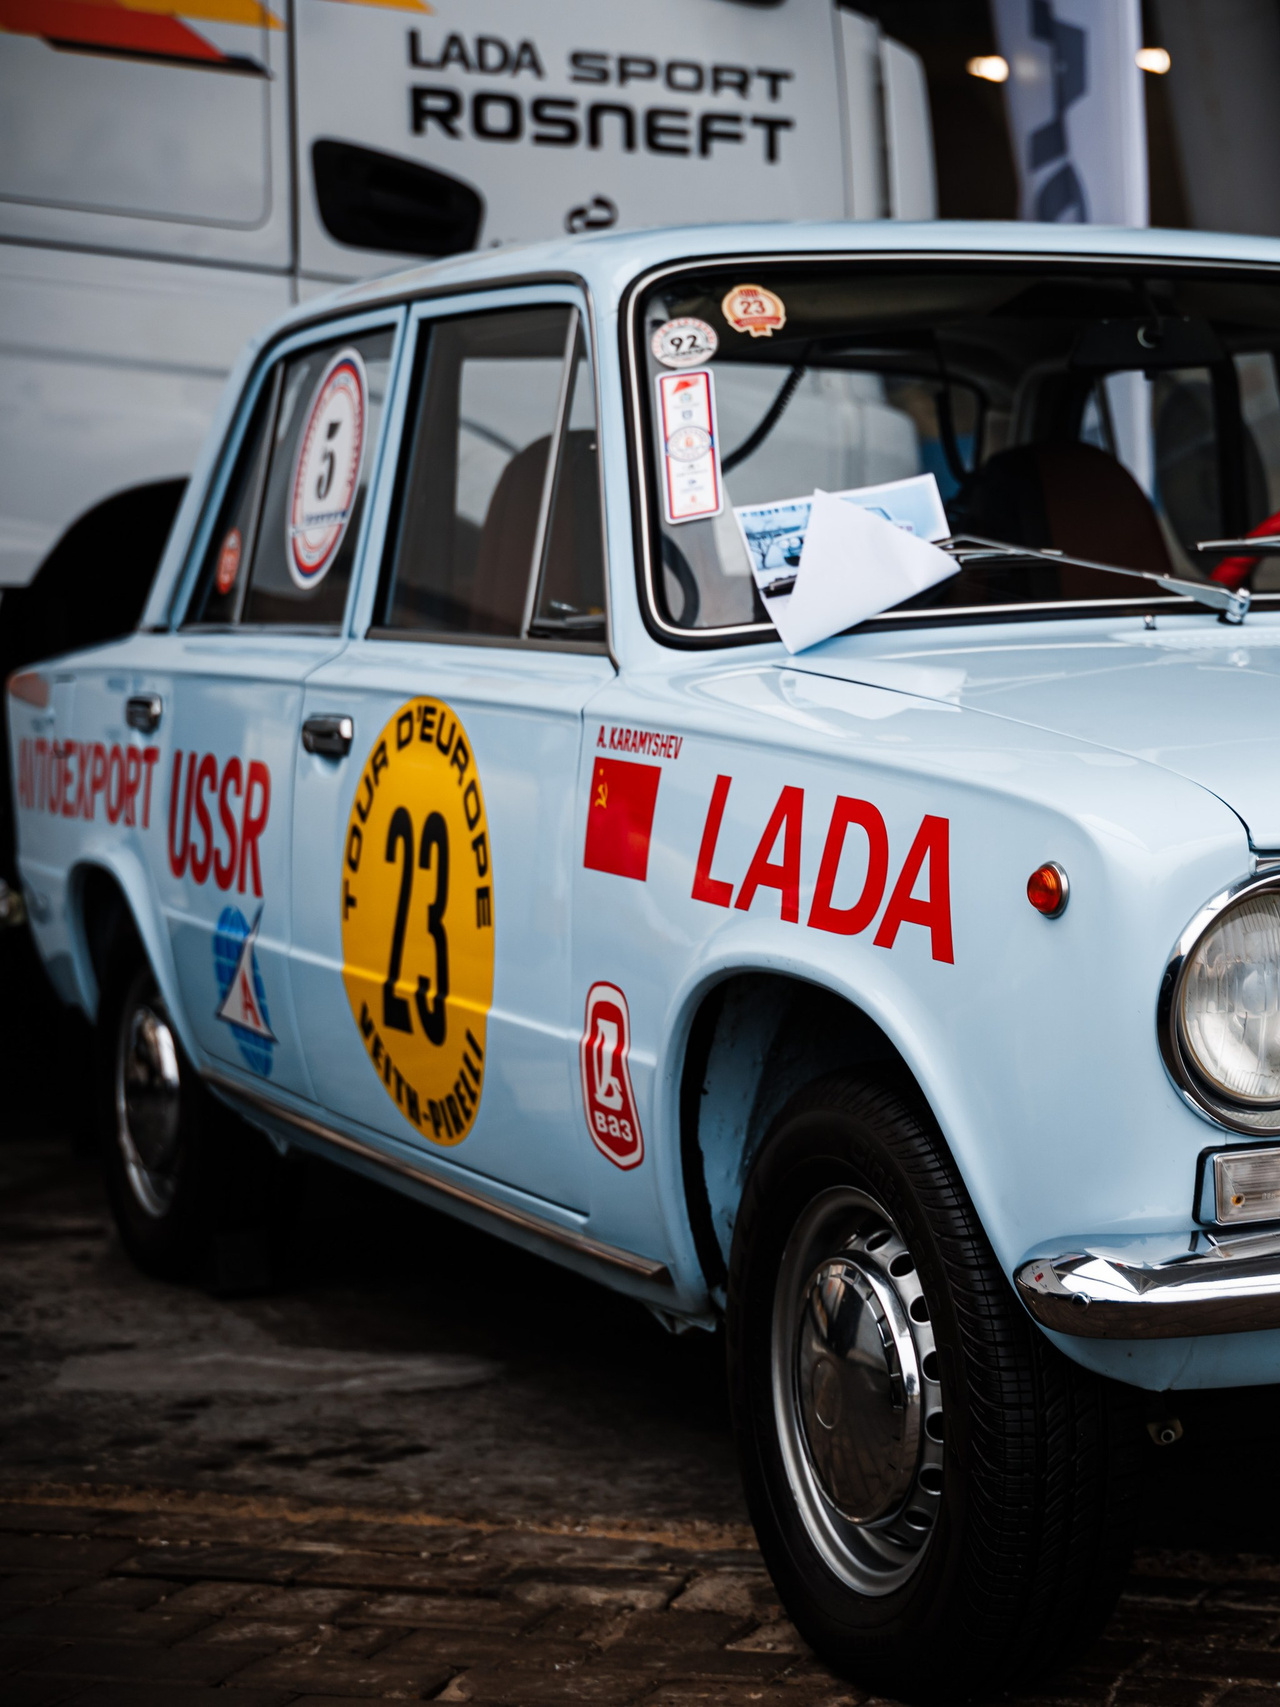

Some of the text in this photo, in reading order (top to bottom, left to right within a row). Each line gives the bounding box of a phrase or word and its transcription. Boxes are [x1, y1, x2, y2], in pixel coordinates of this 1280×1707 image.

[407, 27, 793, 101] LADA SPORT
[409, 83, 794, 165] ROSNEFT
[670, 334, 700, 352] 92
[740, 299, 766, 315] 23
[609, 727, 683, 759] KARAMYSHEV
[168, 749, 271, 898] USSR
[343, 740, 388, 921] TOUR
[691, 774, 955, 965] LADA
[383, 806, 449, 1046] 23
